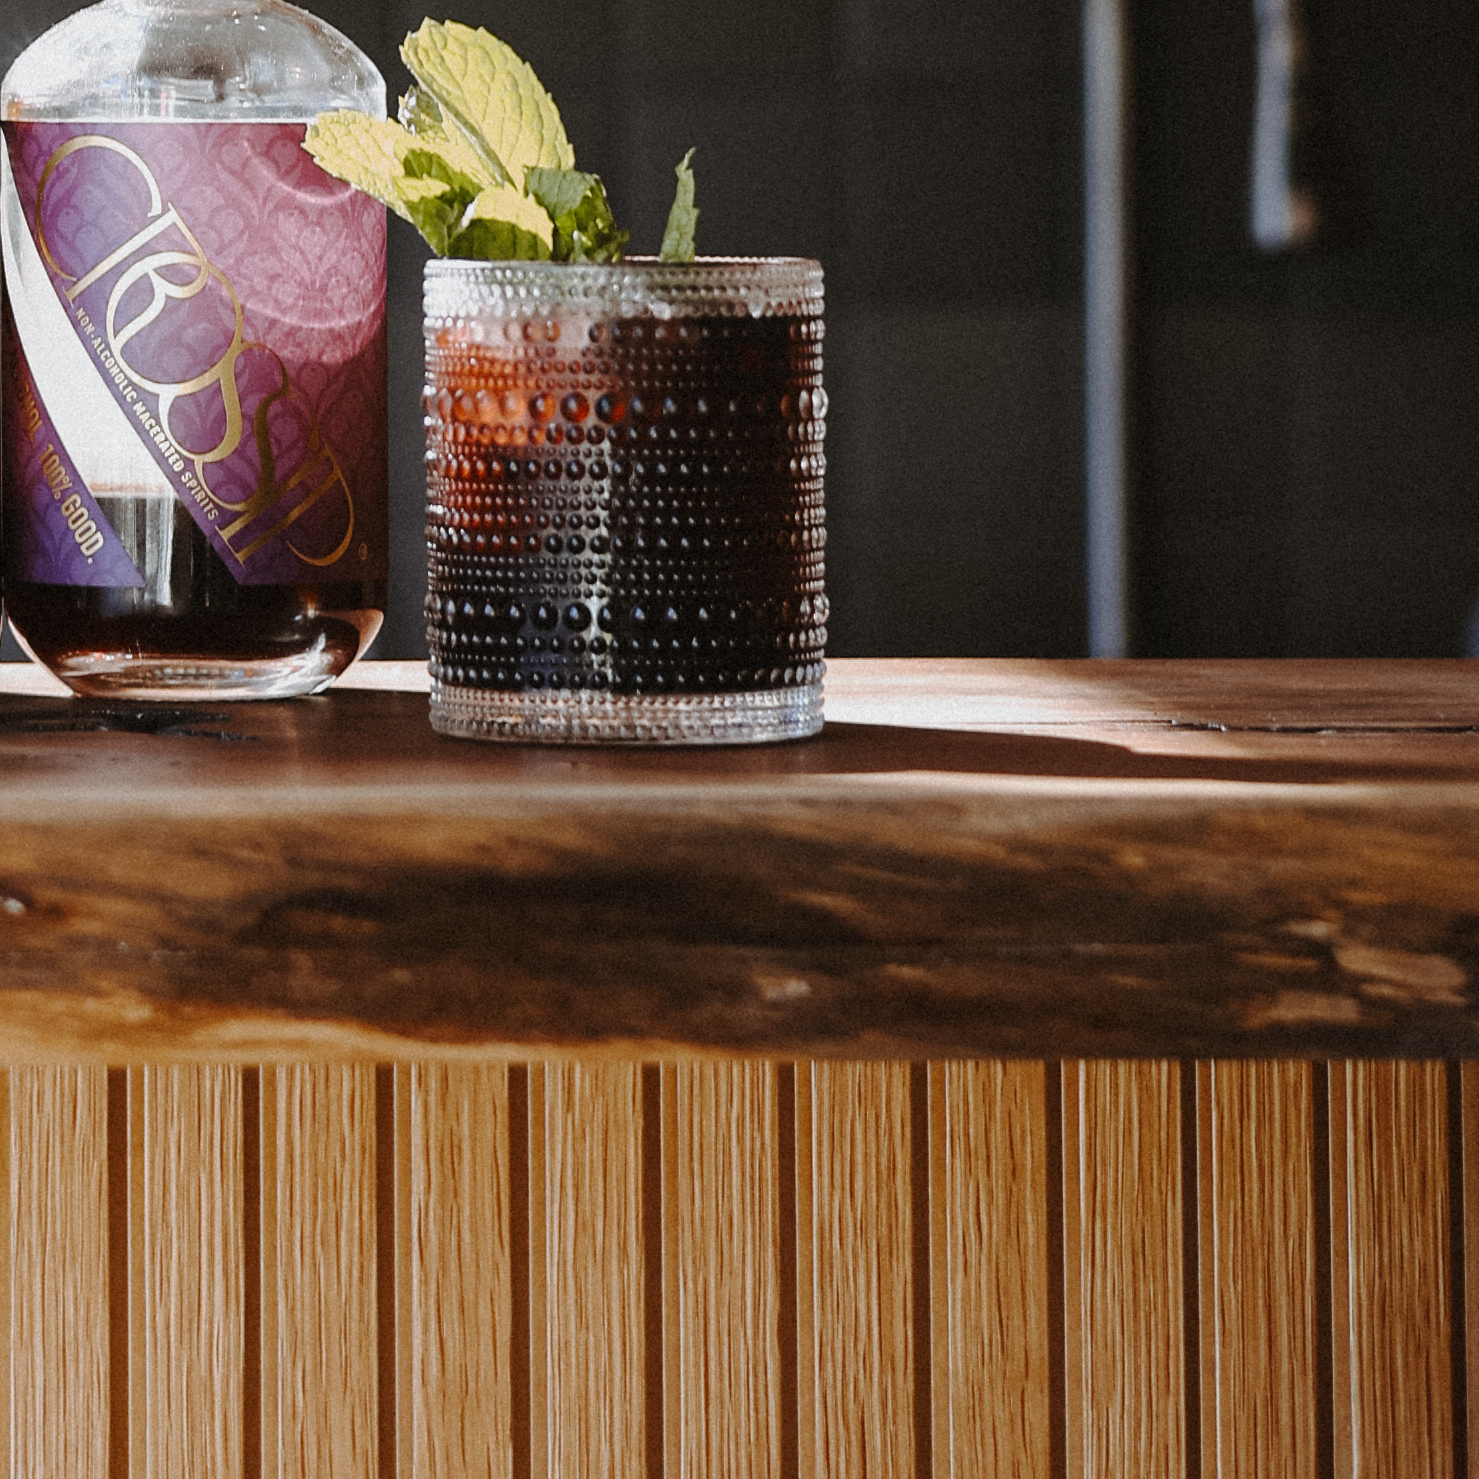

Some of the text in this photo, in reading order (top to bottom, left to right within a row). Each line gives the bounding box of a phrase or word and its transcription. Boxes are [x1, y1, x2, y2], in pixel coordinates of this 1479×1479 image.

[36, 134, 355, 569] CROSSIP
[75, 307, 219, 521] NON-ALCOHOLIC MACERATED SPIRITS
[39, 442, 104, 565] 100% GOOD.
